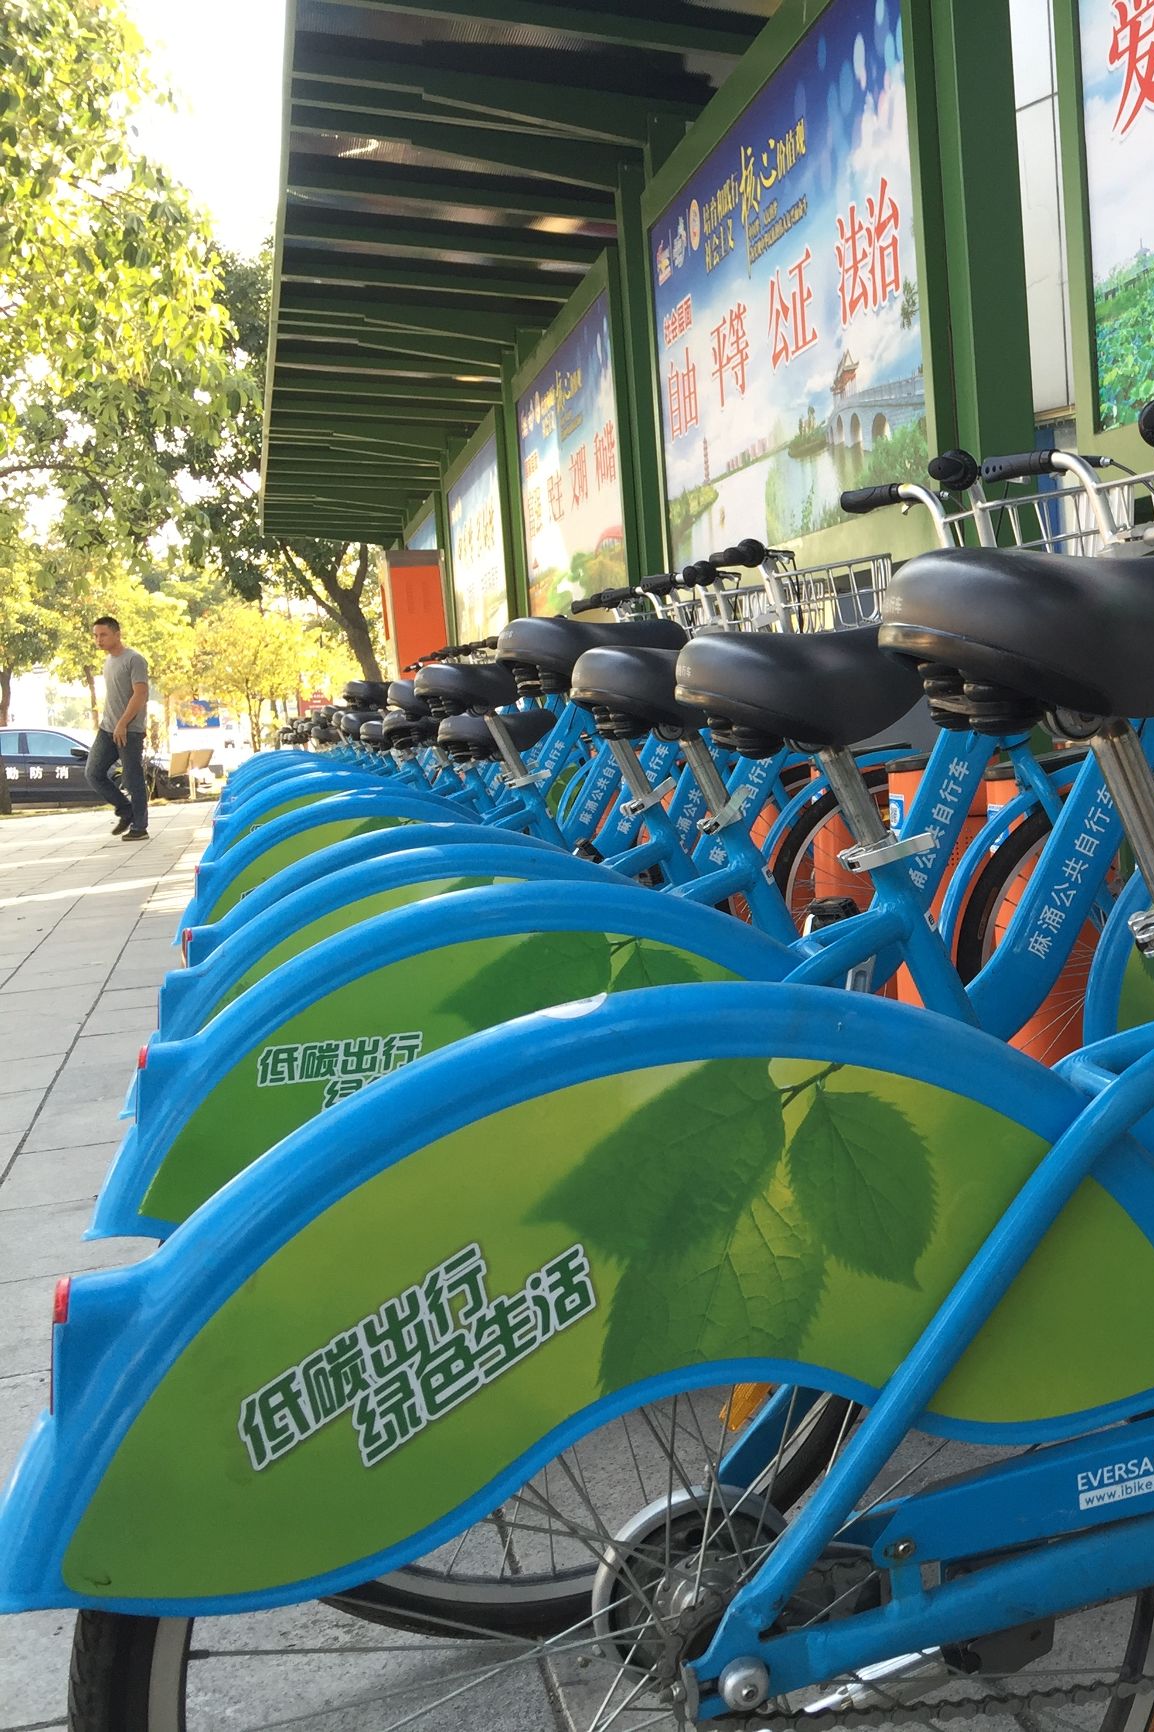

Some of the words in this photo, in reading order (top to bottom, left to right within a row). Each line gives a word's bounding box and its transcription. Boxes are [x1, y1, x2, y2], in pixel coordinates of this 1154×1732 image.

[663, 294, 692, 346] 社会层面
[667, 347, 699, 443] 自由
[710, 302, 749, 408] 平等
[766, 247, 818, 369] 公正
[834, 177, 901, 327] 法治
[568, 443, 588, 512] 文明
[594, 419, 617, 493] 和谐
[1027, 784, 1115, 961] 麻涌公共自行车
[256, 1031, 424, 1088] 低碳出行
[237, 1241, 487, 1472] 低碳出行
[351, 1242, 597, 1469] 绿色生活
